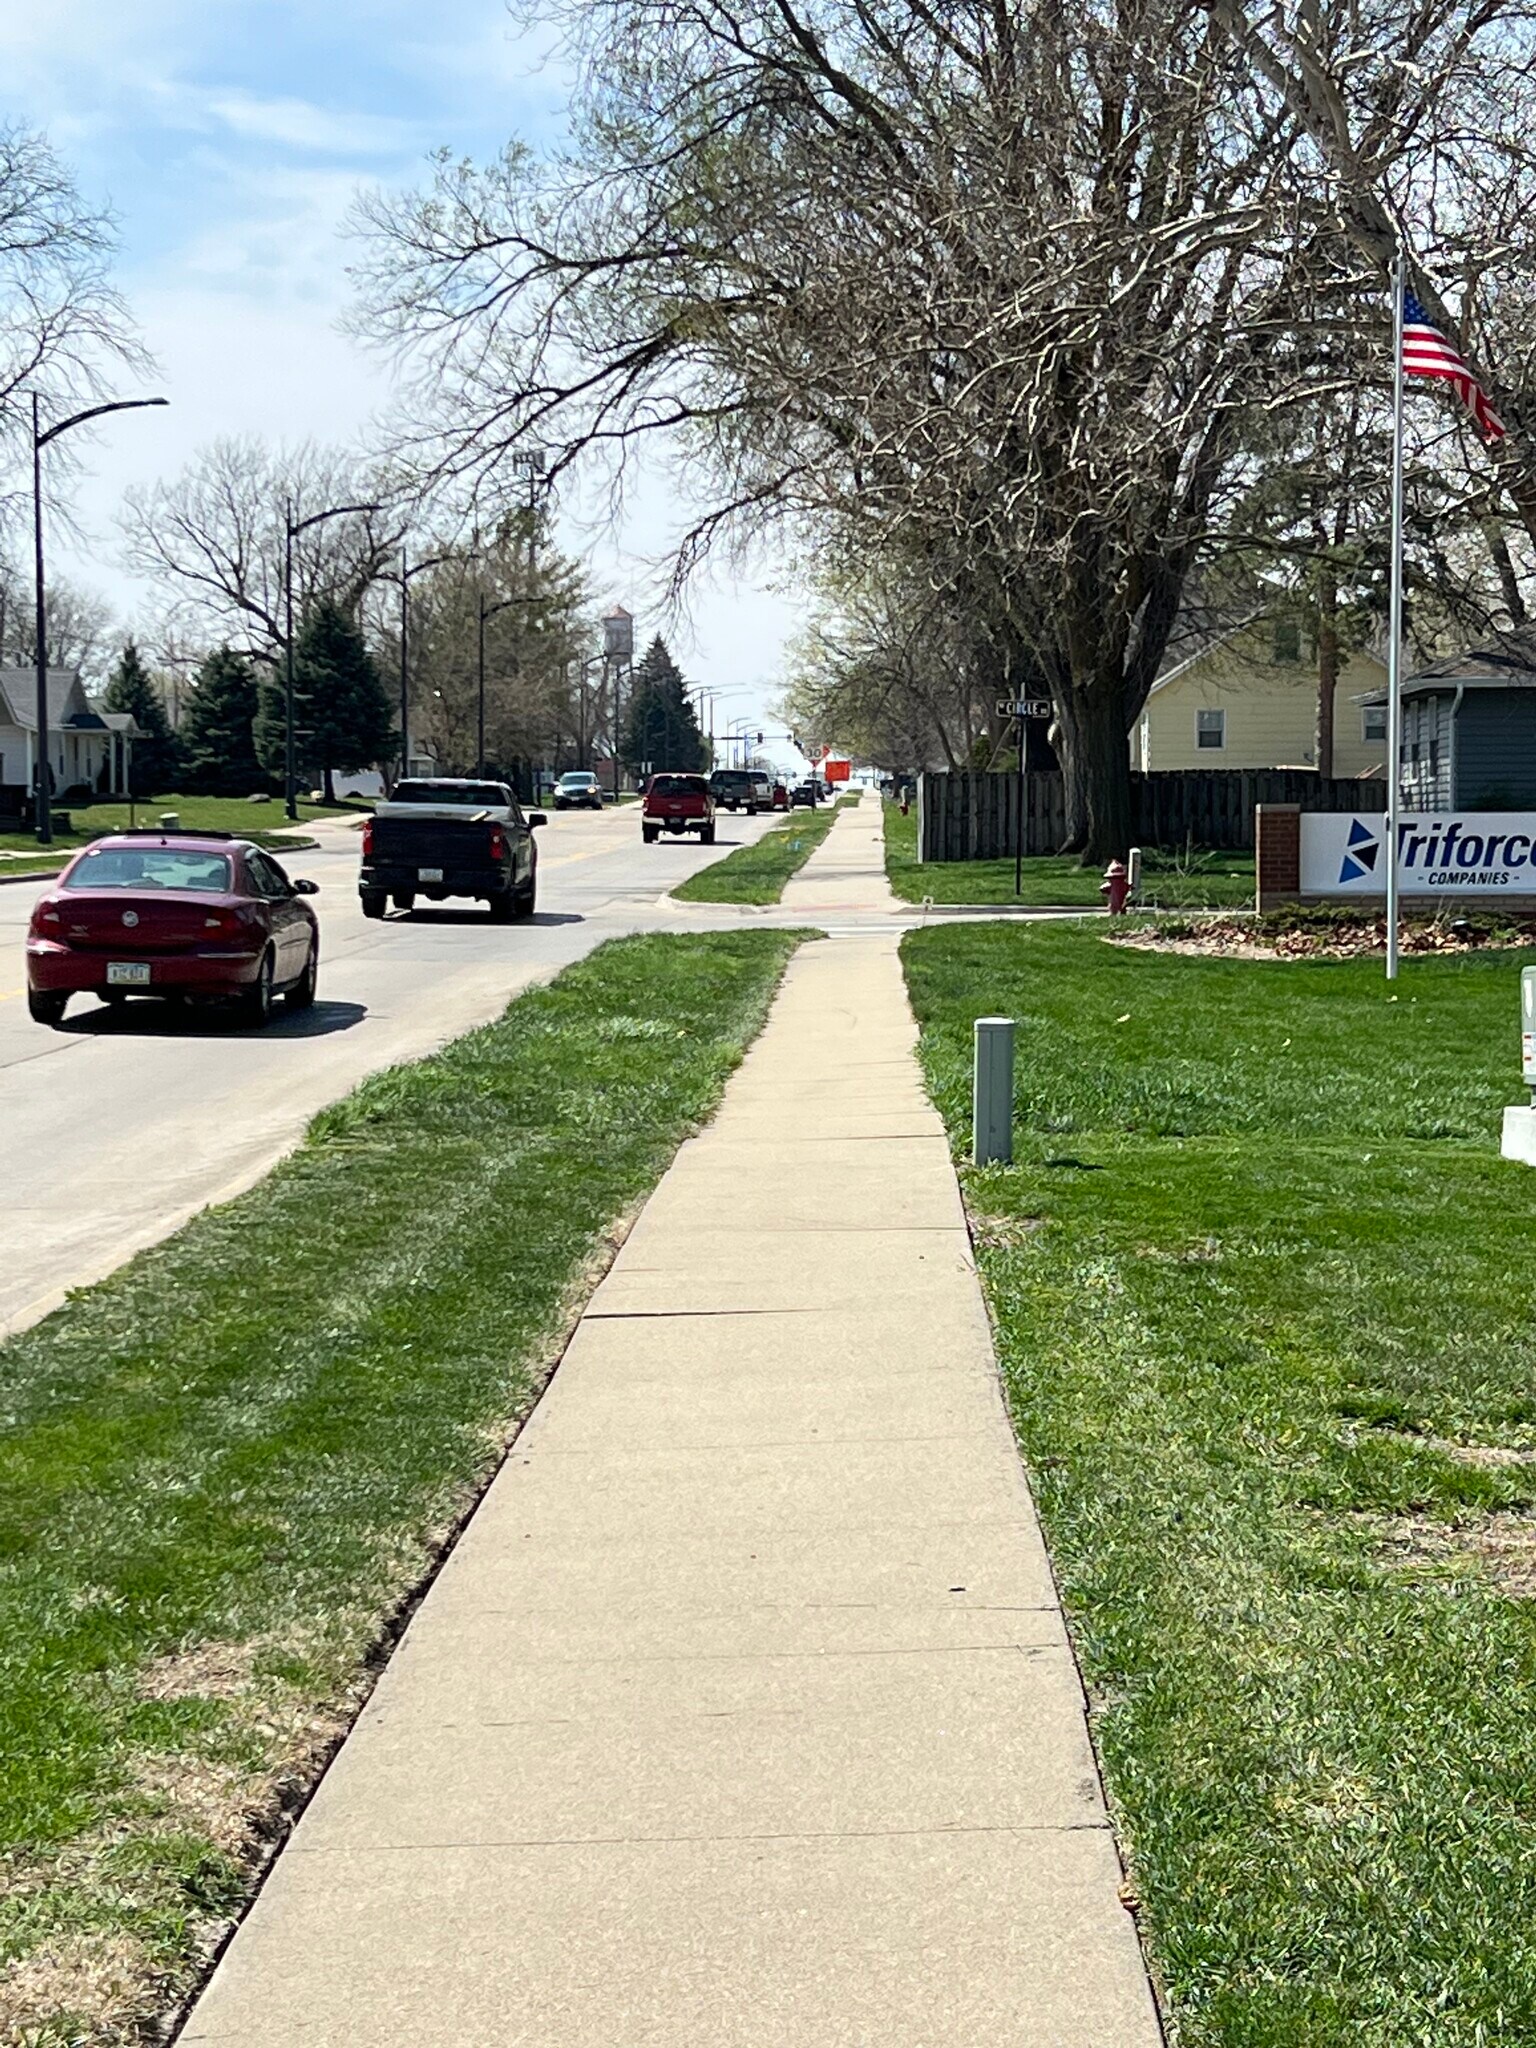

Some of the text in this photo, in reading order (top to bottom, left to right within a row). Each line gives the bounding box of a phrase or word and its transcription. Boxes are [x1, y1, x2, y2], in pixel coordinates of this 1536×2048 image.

[1006, 702, 1038, 715] CIRCLE
[1385, 823, 1536, 868] Triforc
[1428, 872, 1510, 885] COMPANIES
